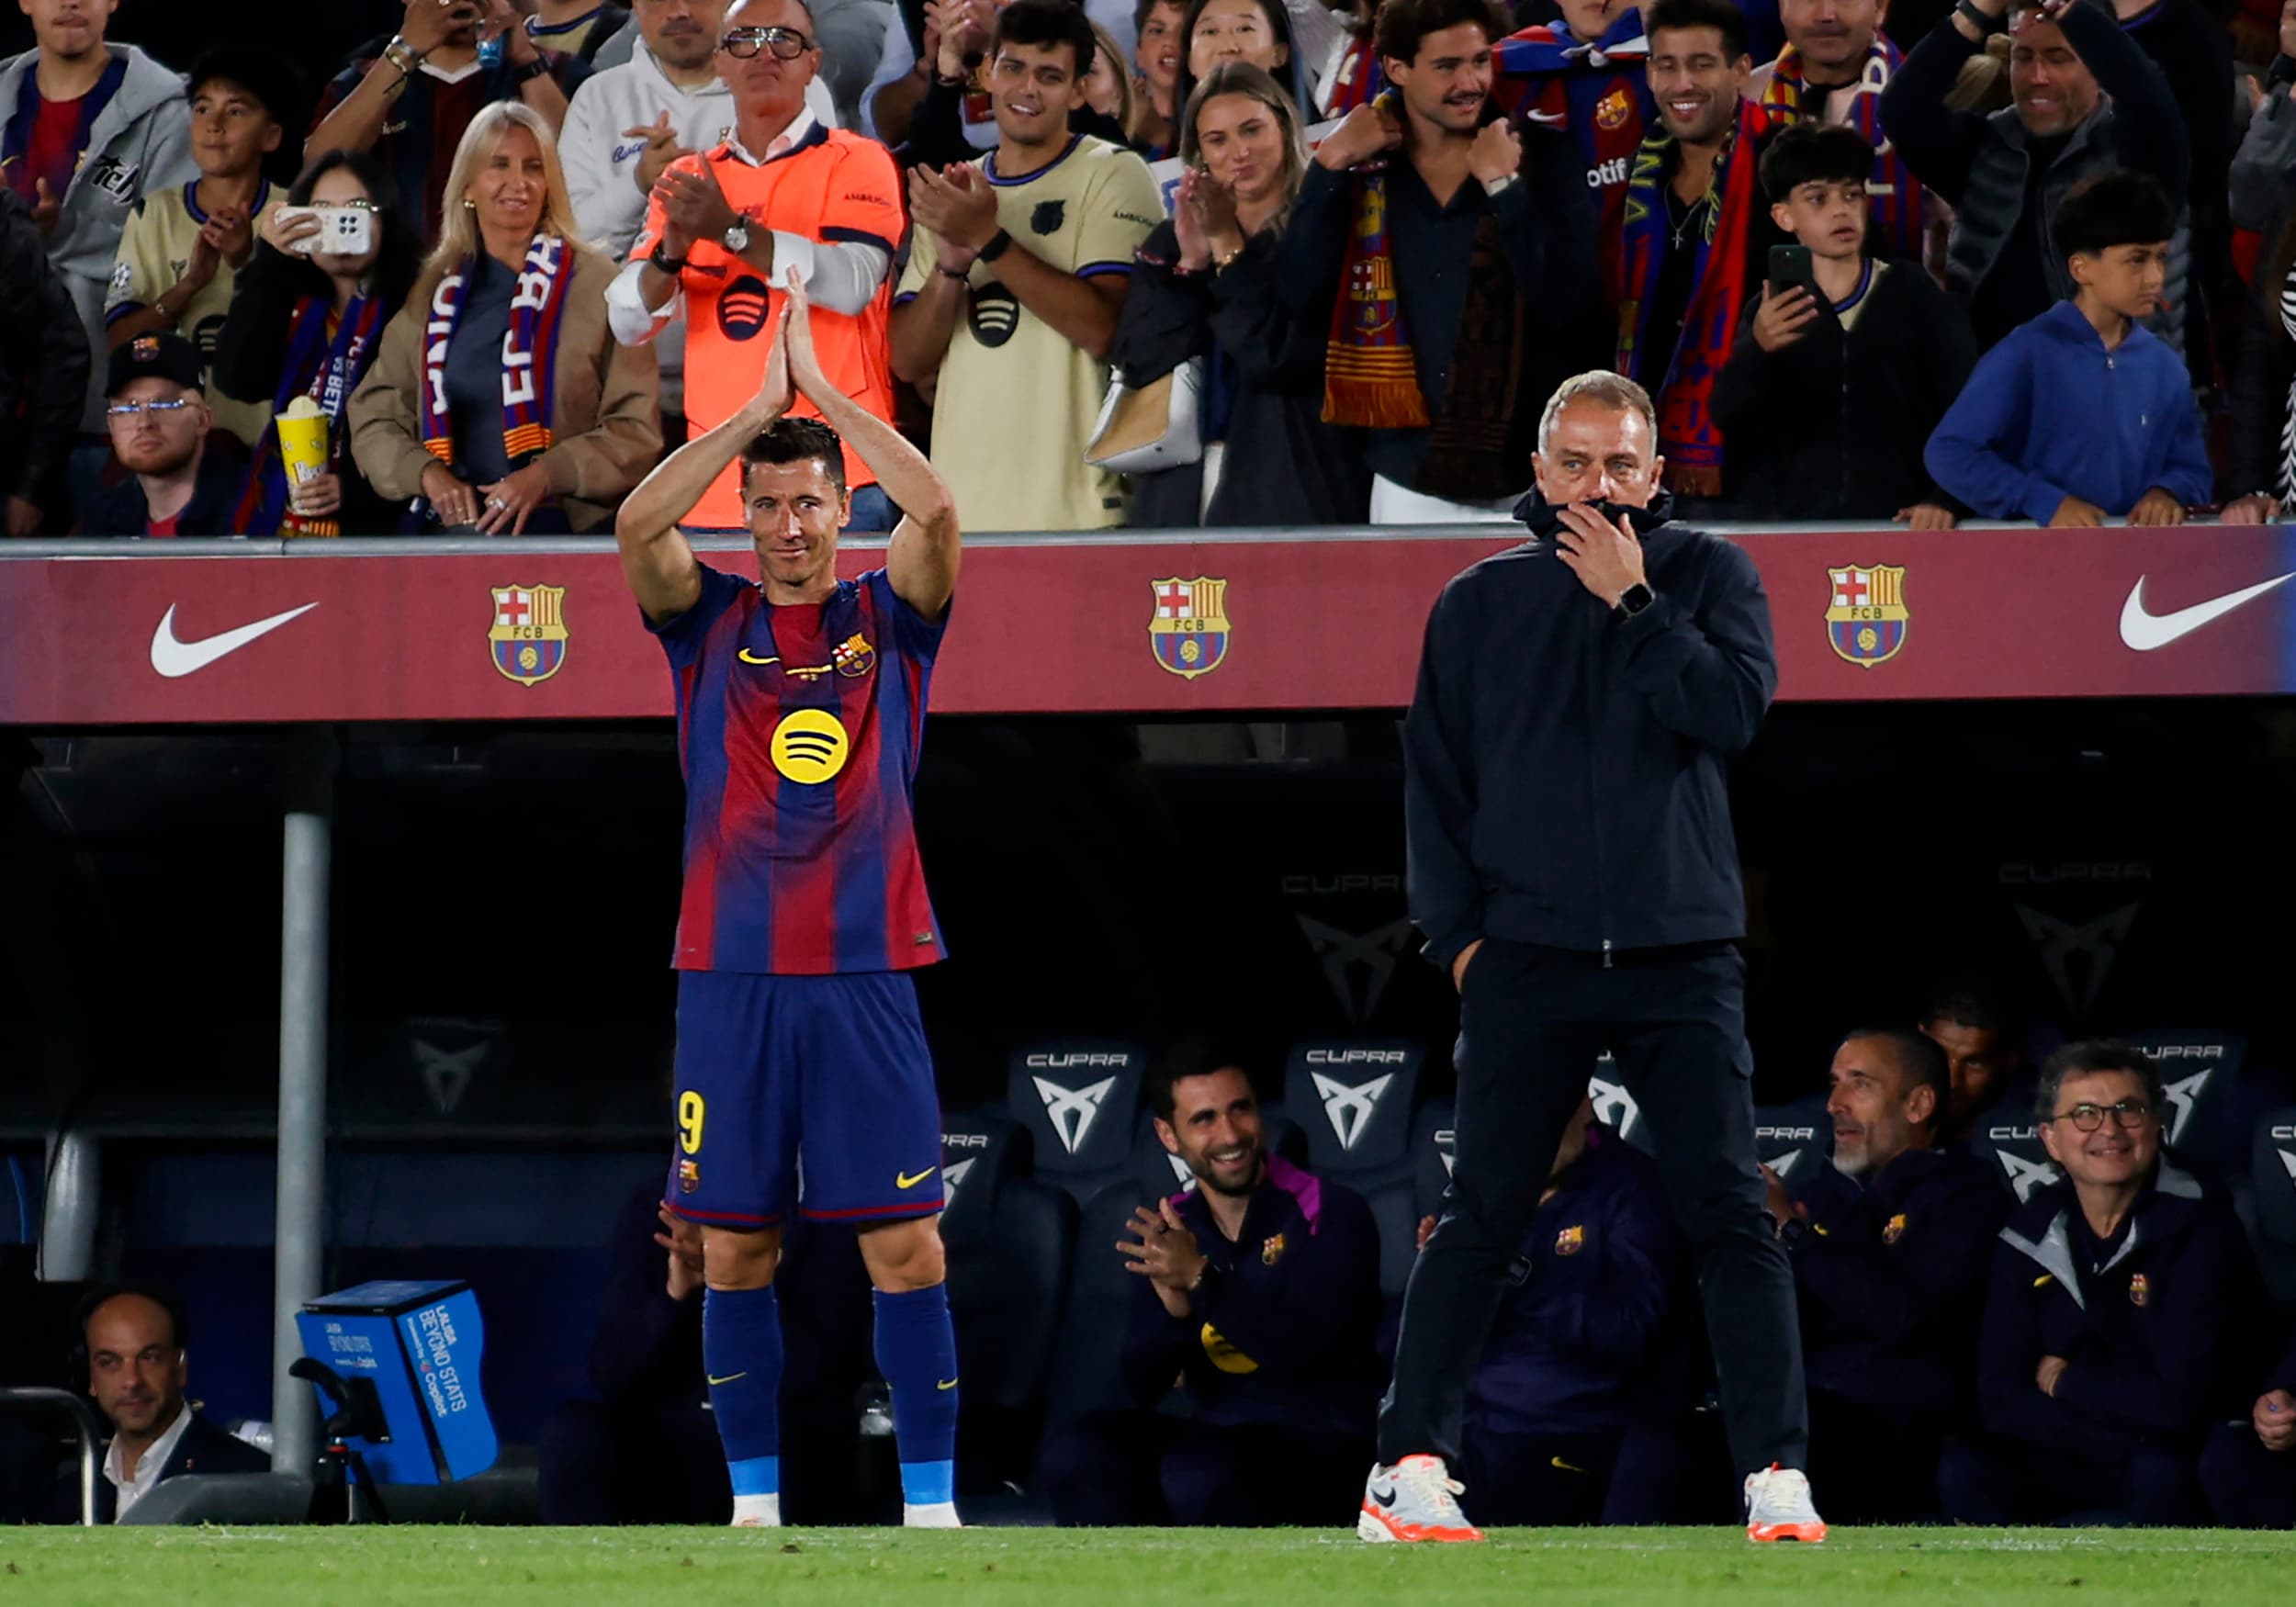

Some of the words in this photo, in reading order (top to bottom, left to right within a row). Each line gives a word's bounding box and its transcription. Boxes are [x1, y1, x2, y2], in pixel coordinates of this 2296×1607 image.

[1586, 156, 1626, 188] otif
[1851, 607, 1882, 619] FCB
[513, 626, 543, 639] FCB
[1174, 619, 1204, 632] FCB
[1280, 874, 1407, 893] CUPR
[1026, 1052, 1129, 1068] CUPRA
[1305, 1049, 1406, 1064] CUPRA
[2140, 1045, 2223, 1060] UPRA
[678, 1090, 705, 1155] 9
[1755, 1126, 1814, 1141] PRA
[419, 1309, 451, 1366] BEYOND
[439, 1365, 467, 1412] STATS
[424, 1372, 448, 1418] Copilot
